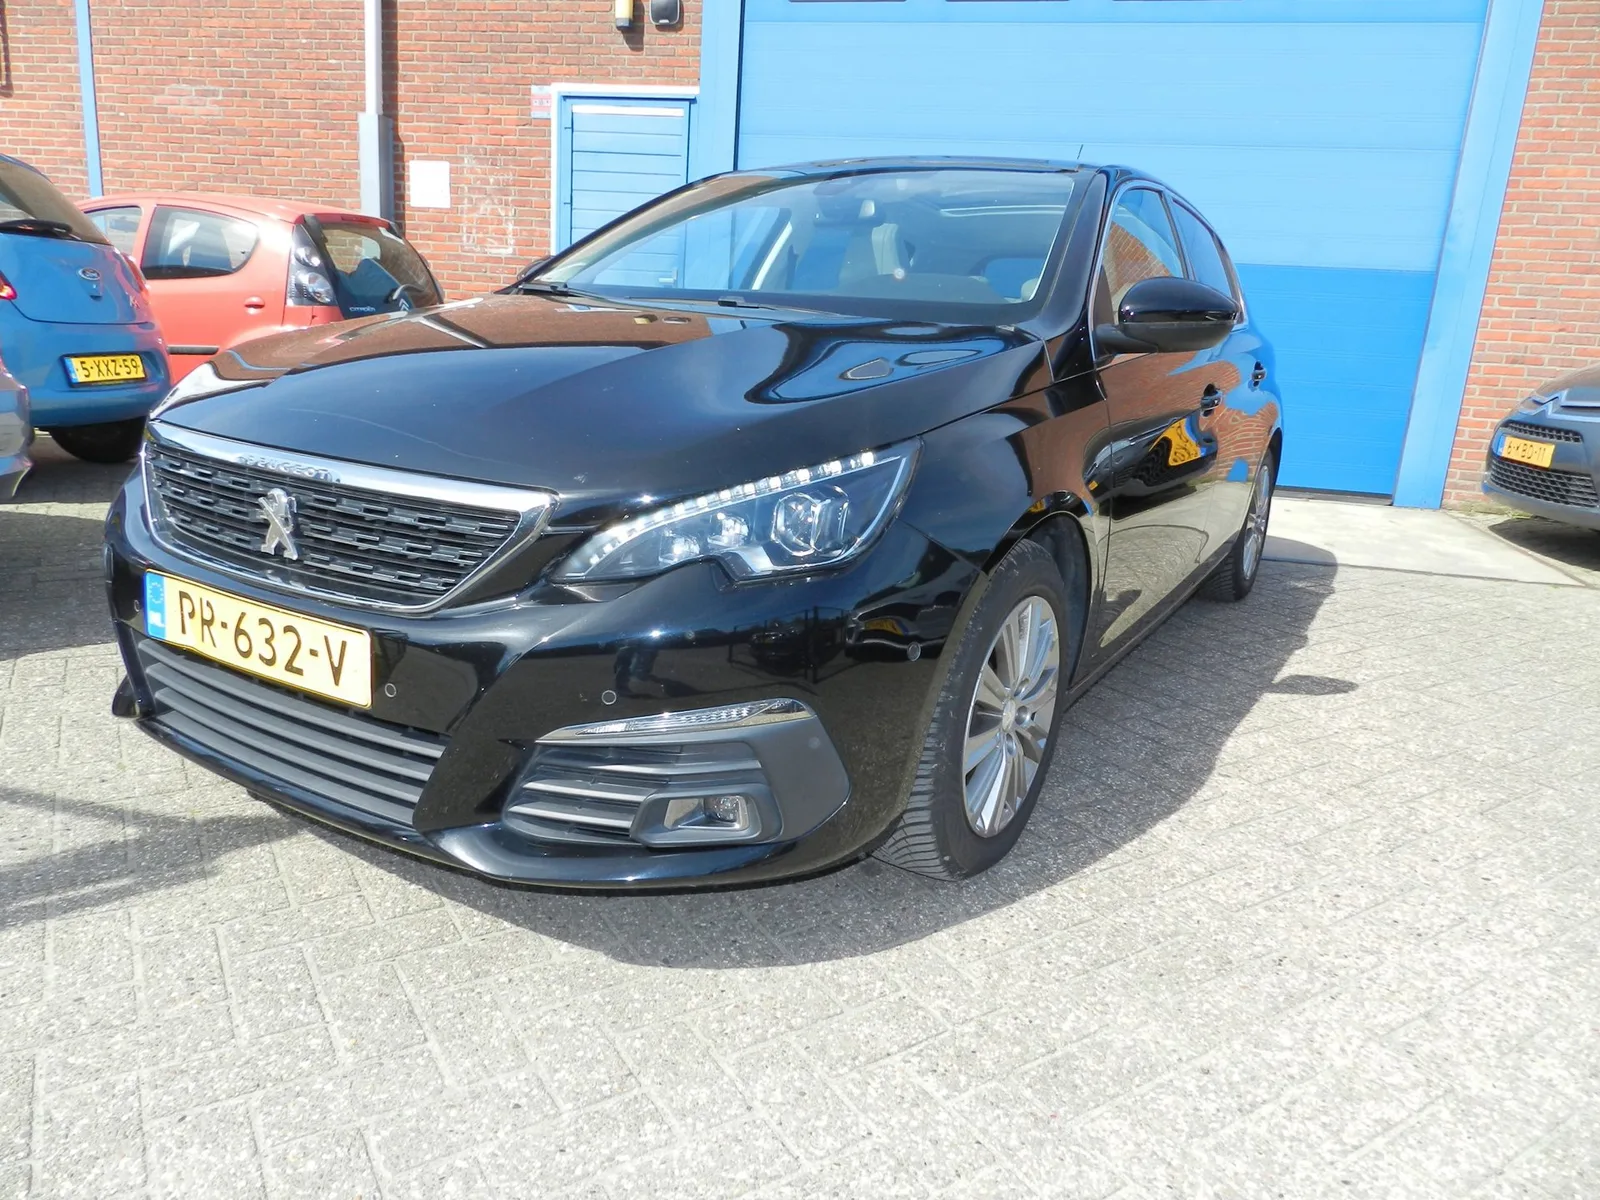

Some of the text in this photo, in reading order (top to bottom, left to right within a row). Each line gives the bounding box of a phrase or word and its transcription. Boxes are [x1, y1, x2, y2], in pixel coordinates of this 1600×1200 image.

[79, 358, 139, 379] 5-XXZ-59
[246, 455, 329, 480] PEUGEOT
[178, 589, 348, 687] PR-632-V
